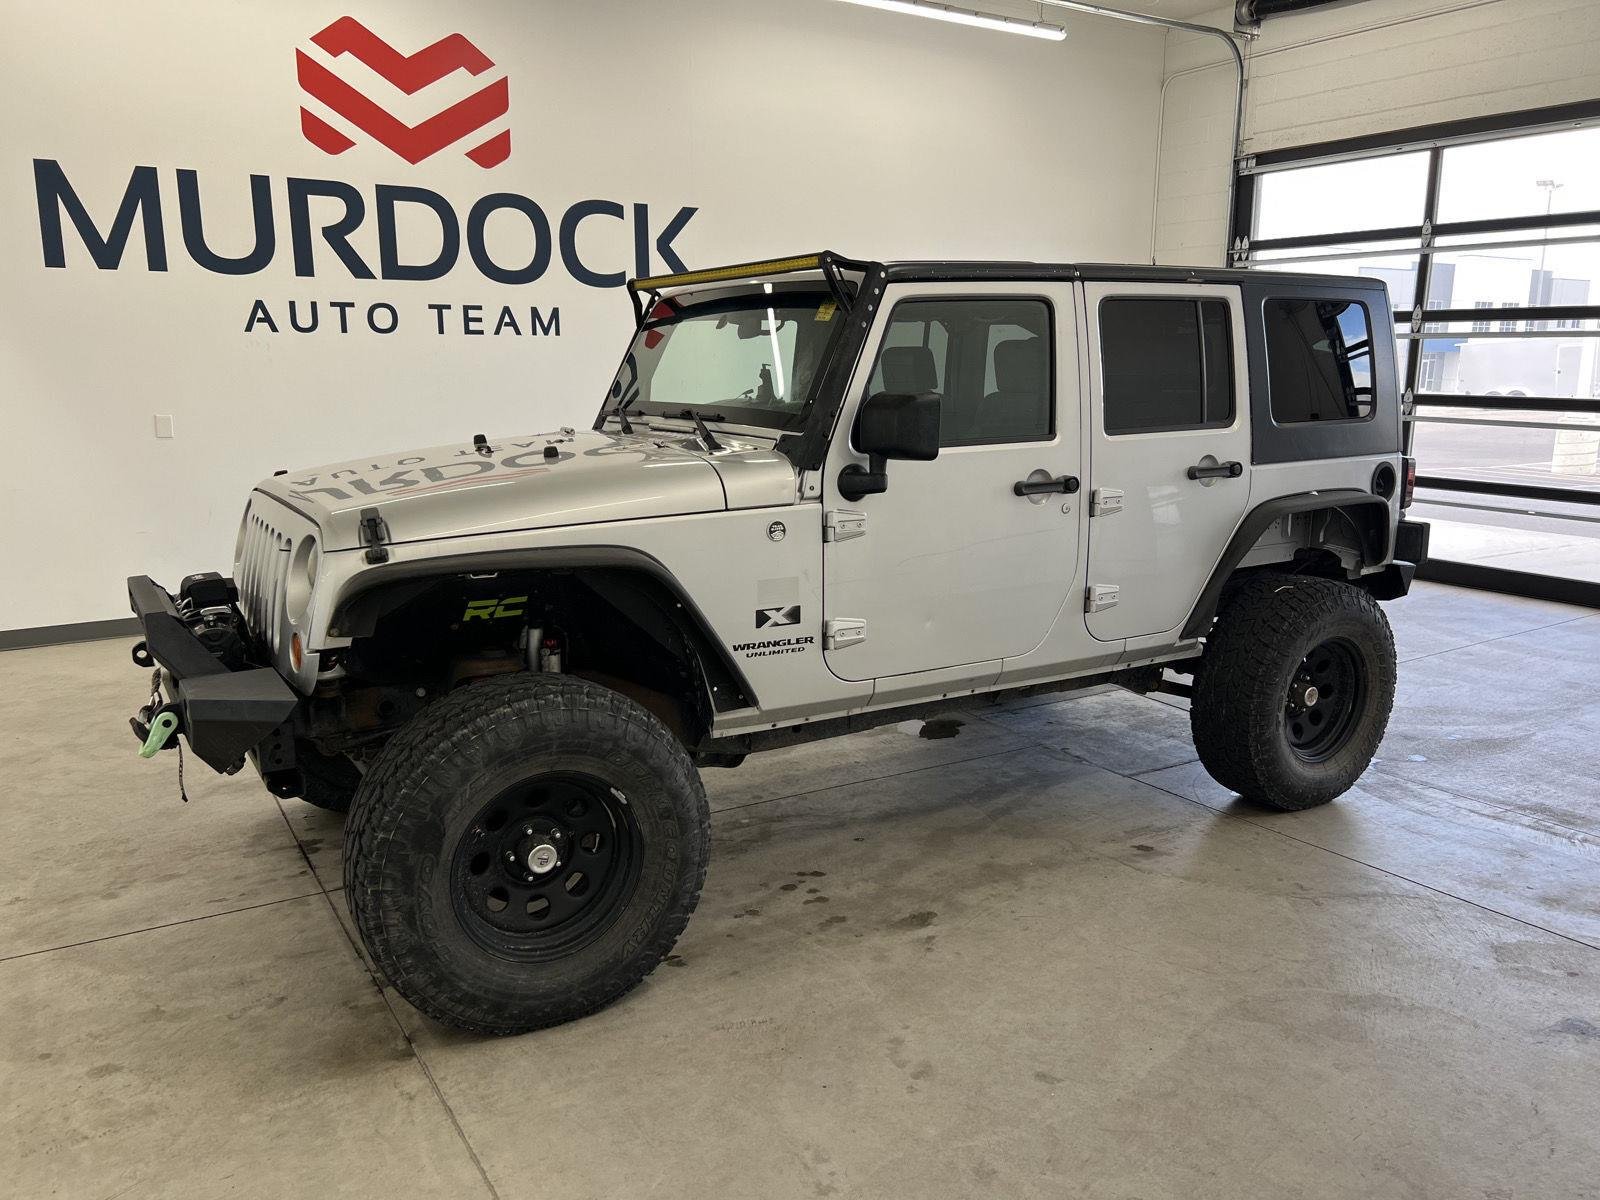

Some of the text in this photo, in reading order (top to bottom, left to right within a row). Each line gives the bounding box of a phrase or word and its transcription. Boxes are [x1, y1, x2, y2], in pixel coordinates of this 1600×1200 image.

[33, 159, 698, 288] MURDOCK
[244, 300, 561, 336] AUTO TEAM
[463, 596, 528, 621] RC
[732, 636, 815, 652] WRANGLER
[746, 646, 806, 659] UNLIMITED
